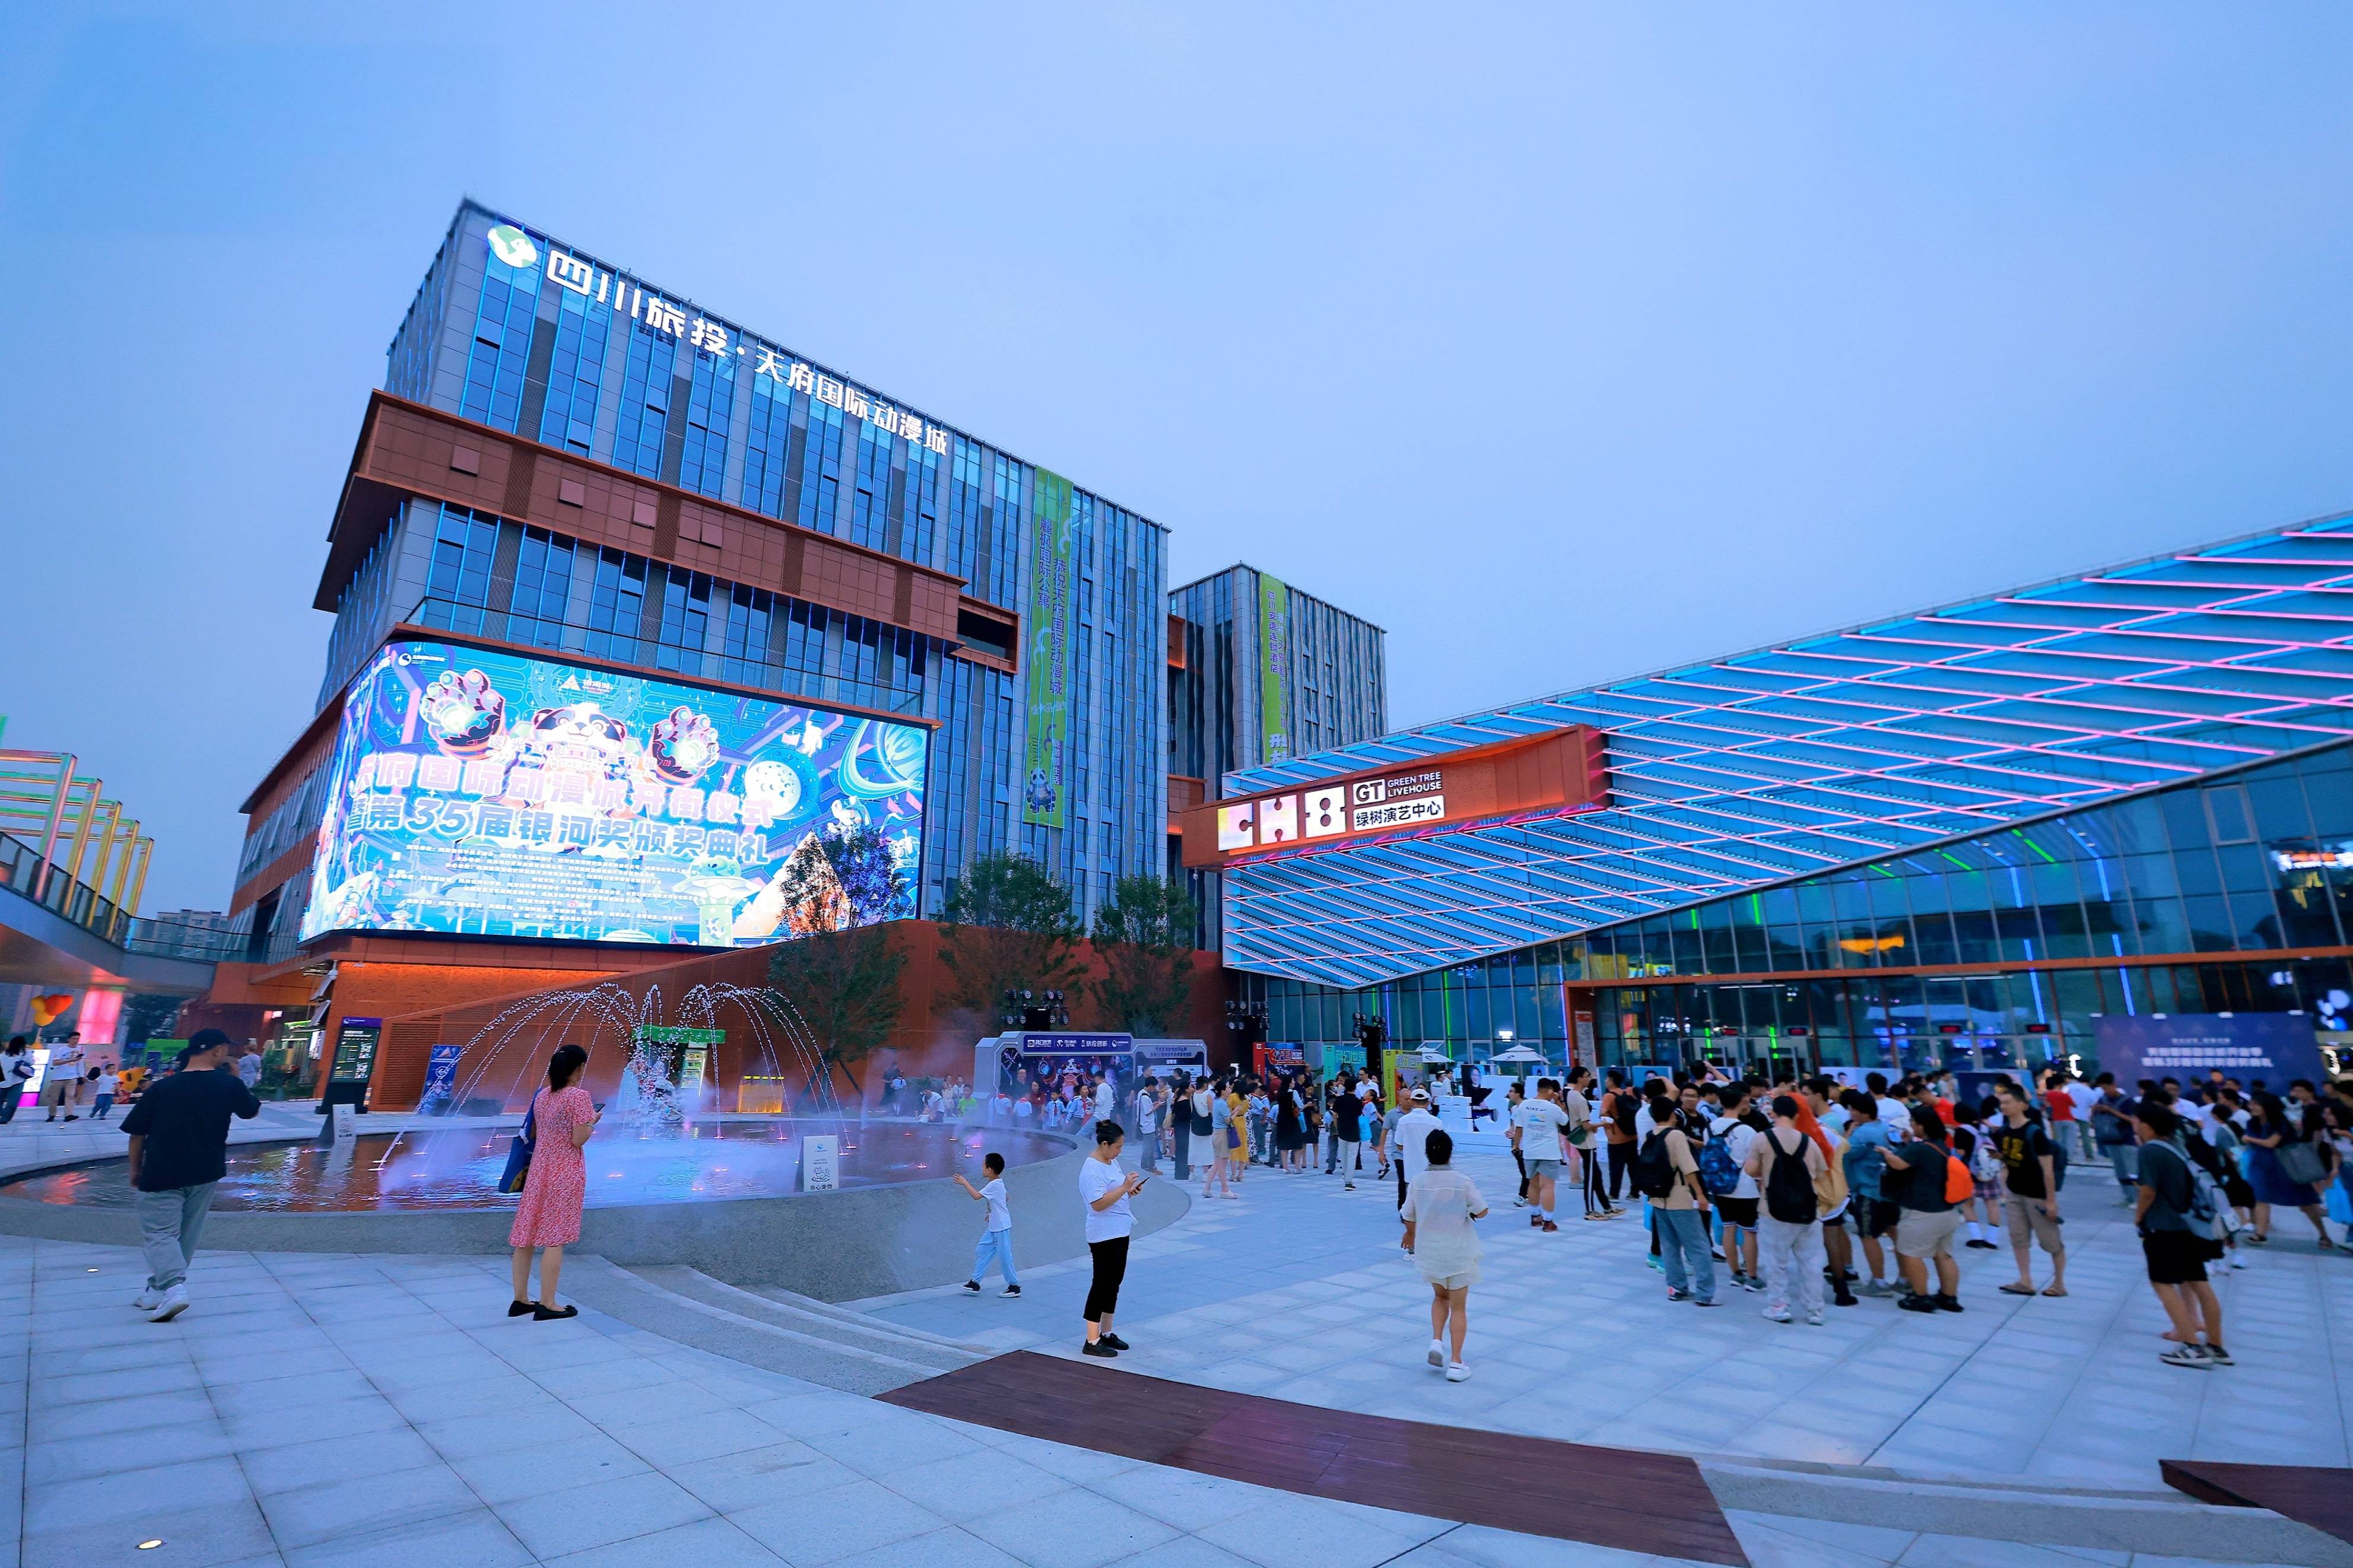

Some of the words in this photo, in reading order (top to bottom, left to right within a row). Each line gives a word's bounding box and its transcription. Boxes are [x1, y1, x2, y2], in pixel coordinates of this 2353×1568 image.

[1050, 558, 1067, 695] 恭祝天府国际动漫城
[355, 753, 774, 827] 天府国际动漫城开街仪式
[1355, 781, 1384, 803] GT
[1387, 775, 1417, 788] GREEN
[1418, 772, 1442, 783] TREE
[1387, 781, 1443, 798] LIVEHOUSE
[1355, 801, 1442, 827] 绿树演艺中心
